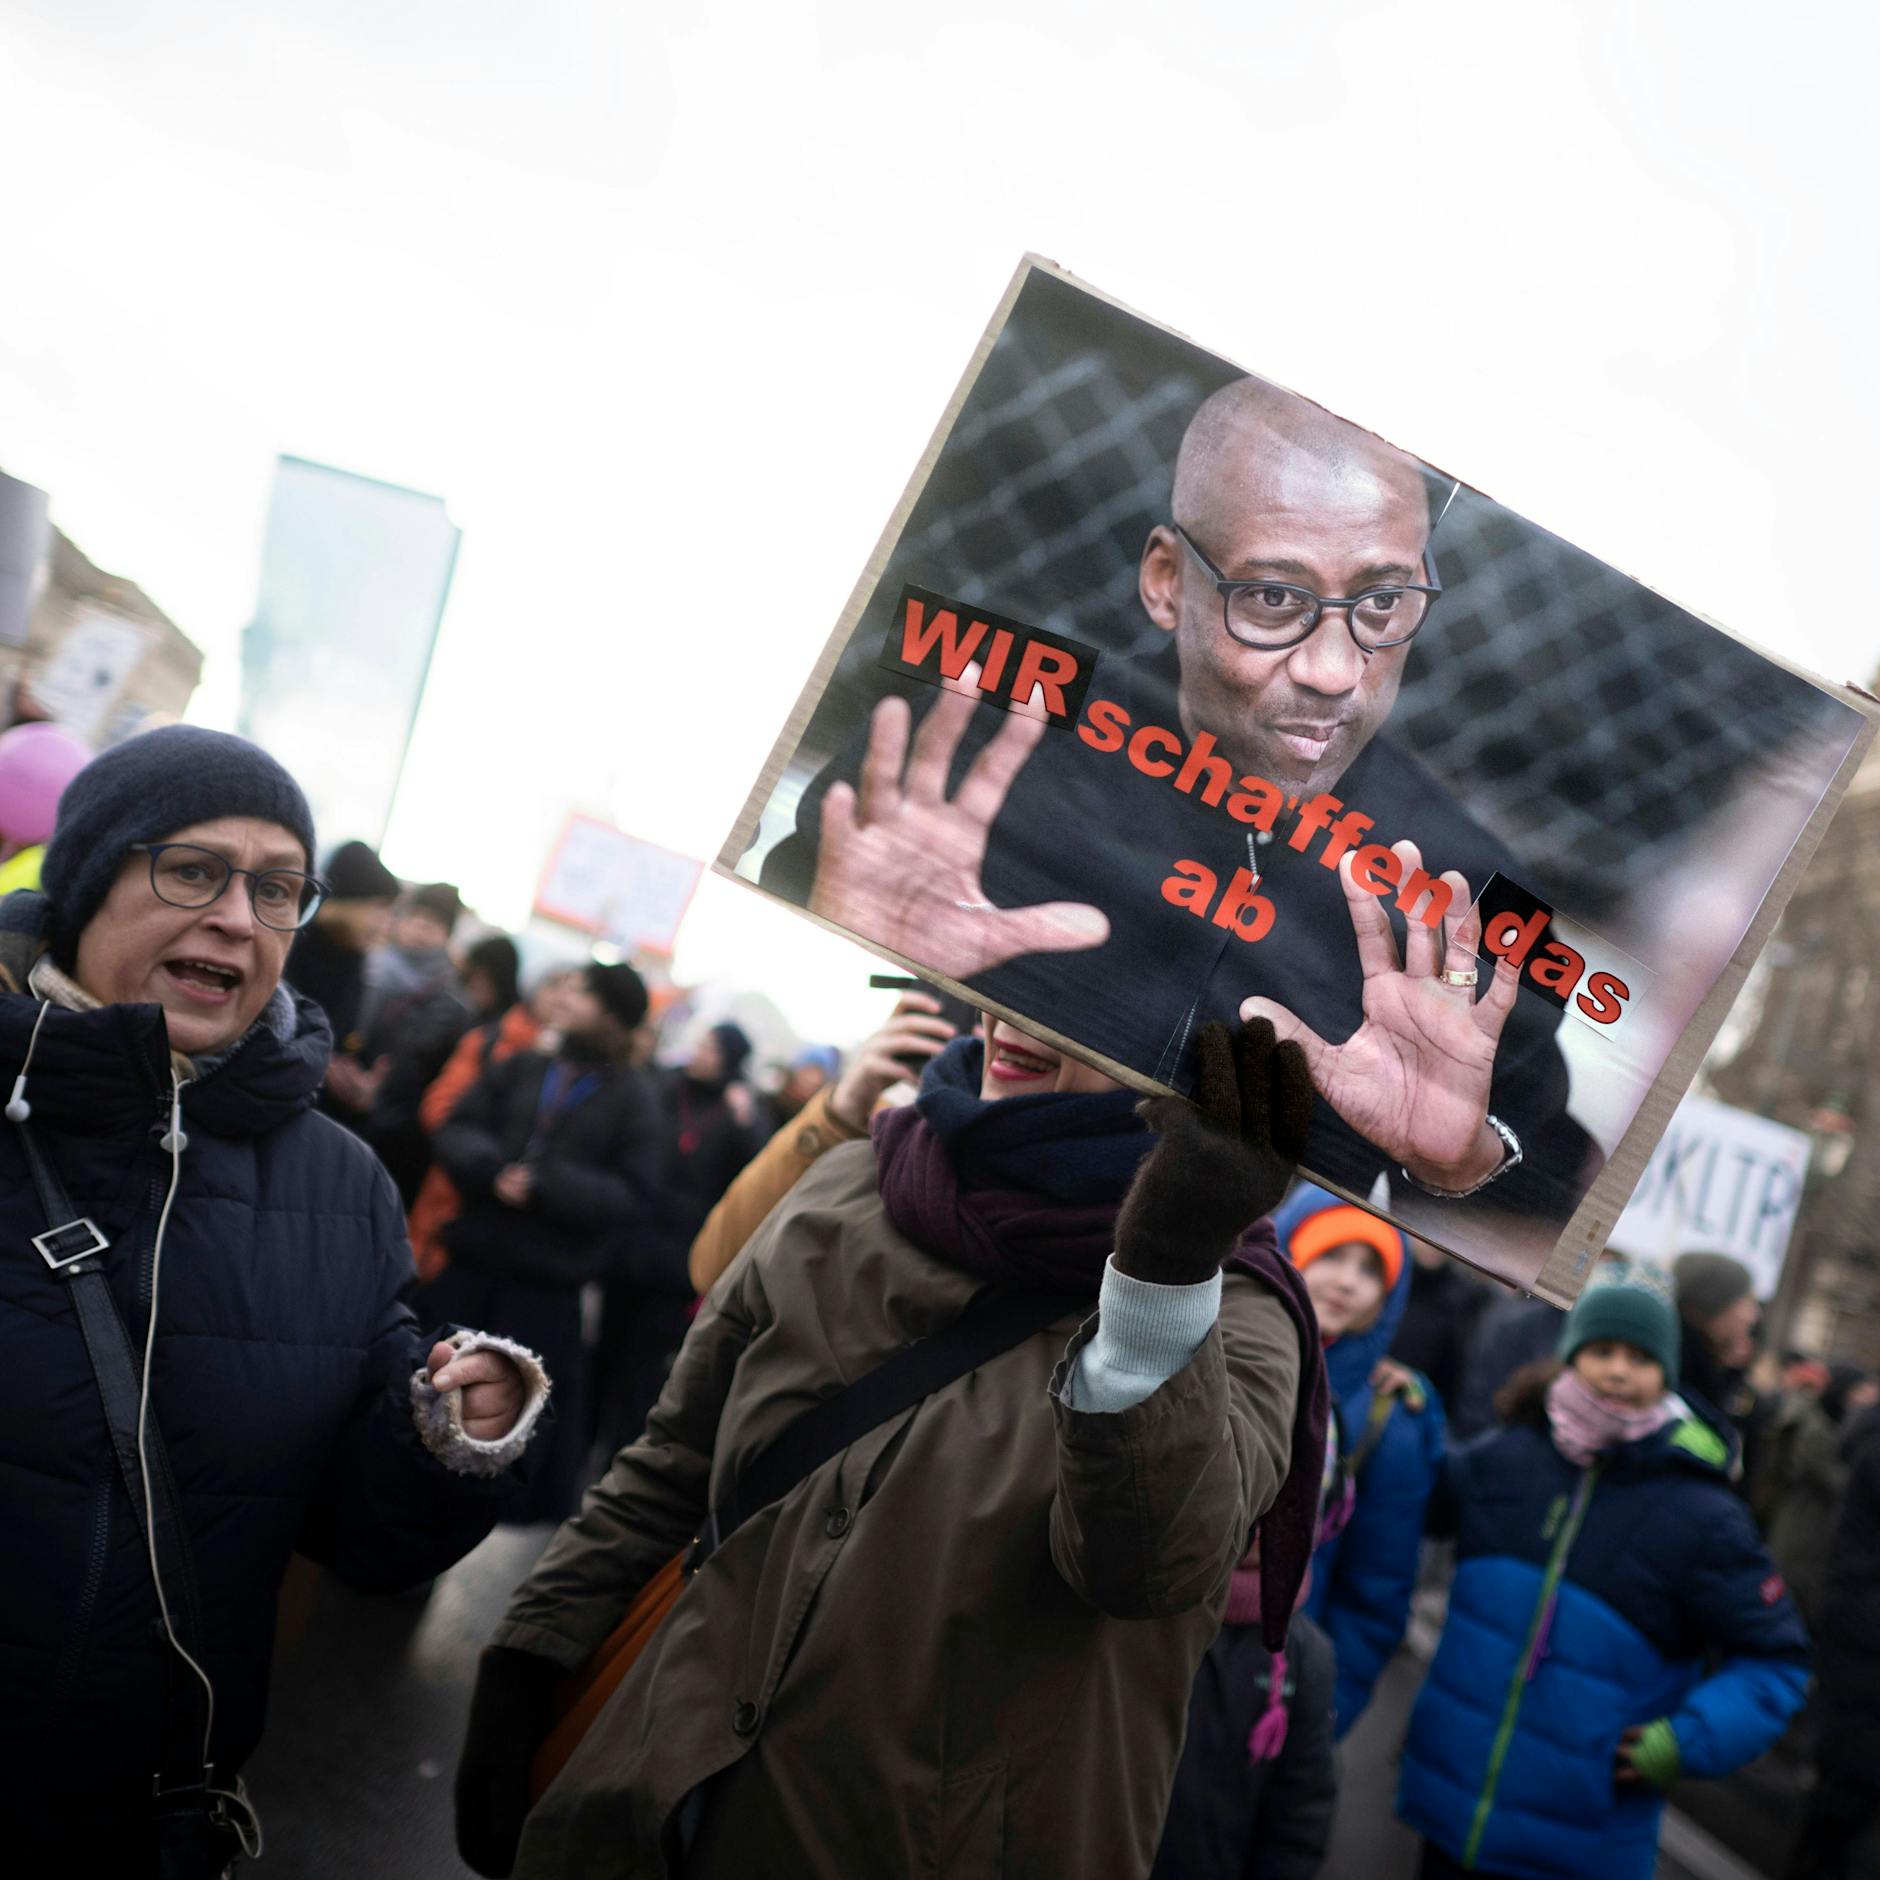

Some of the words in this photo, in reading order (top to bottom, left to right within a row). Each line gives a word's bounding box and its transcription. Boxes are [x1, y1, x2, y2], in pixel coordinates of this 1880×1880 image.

[901, 597, 1079, 718] WIR
[1077, 699, 1454, 929] schaffen
[1483, 909, 1632, 1025] das
[1160, 858, 1277, 943] ab
